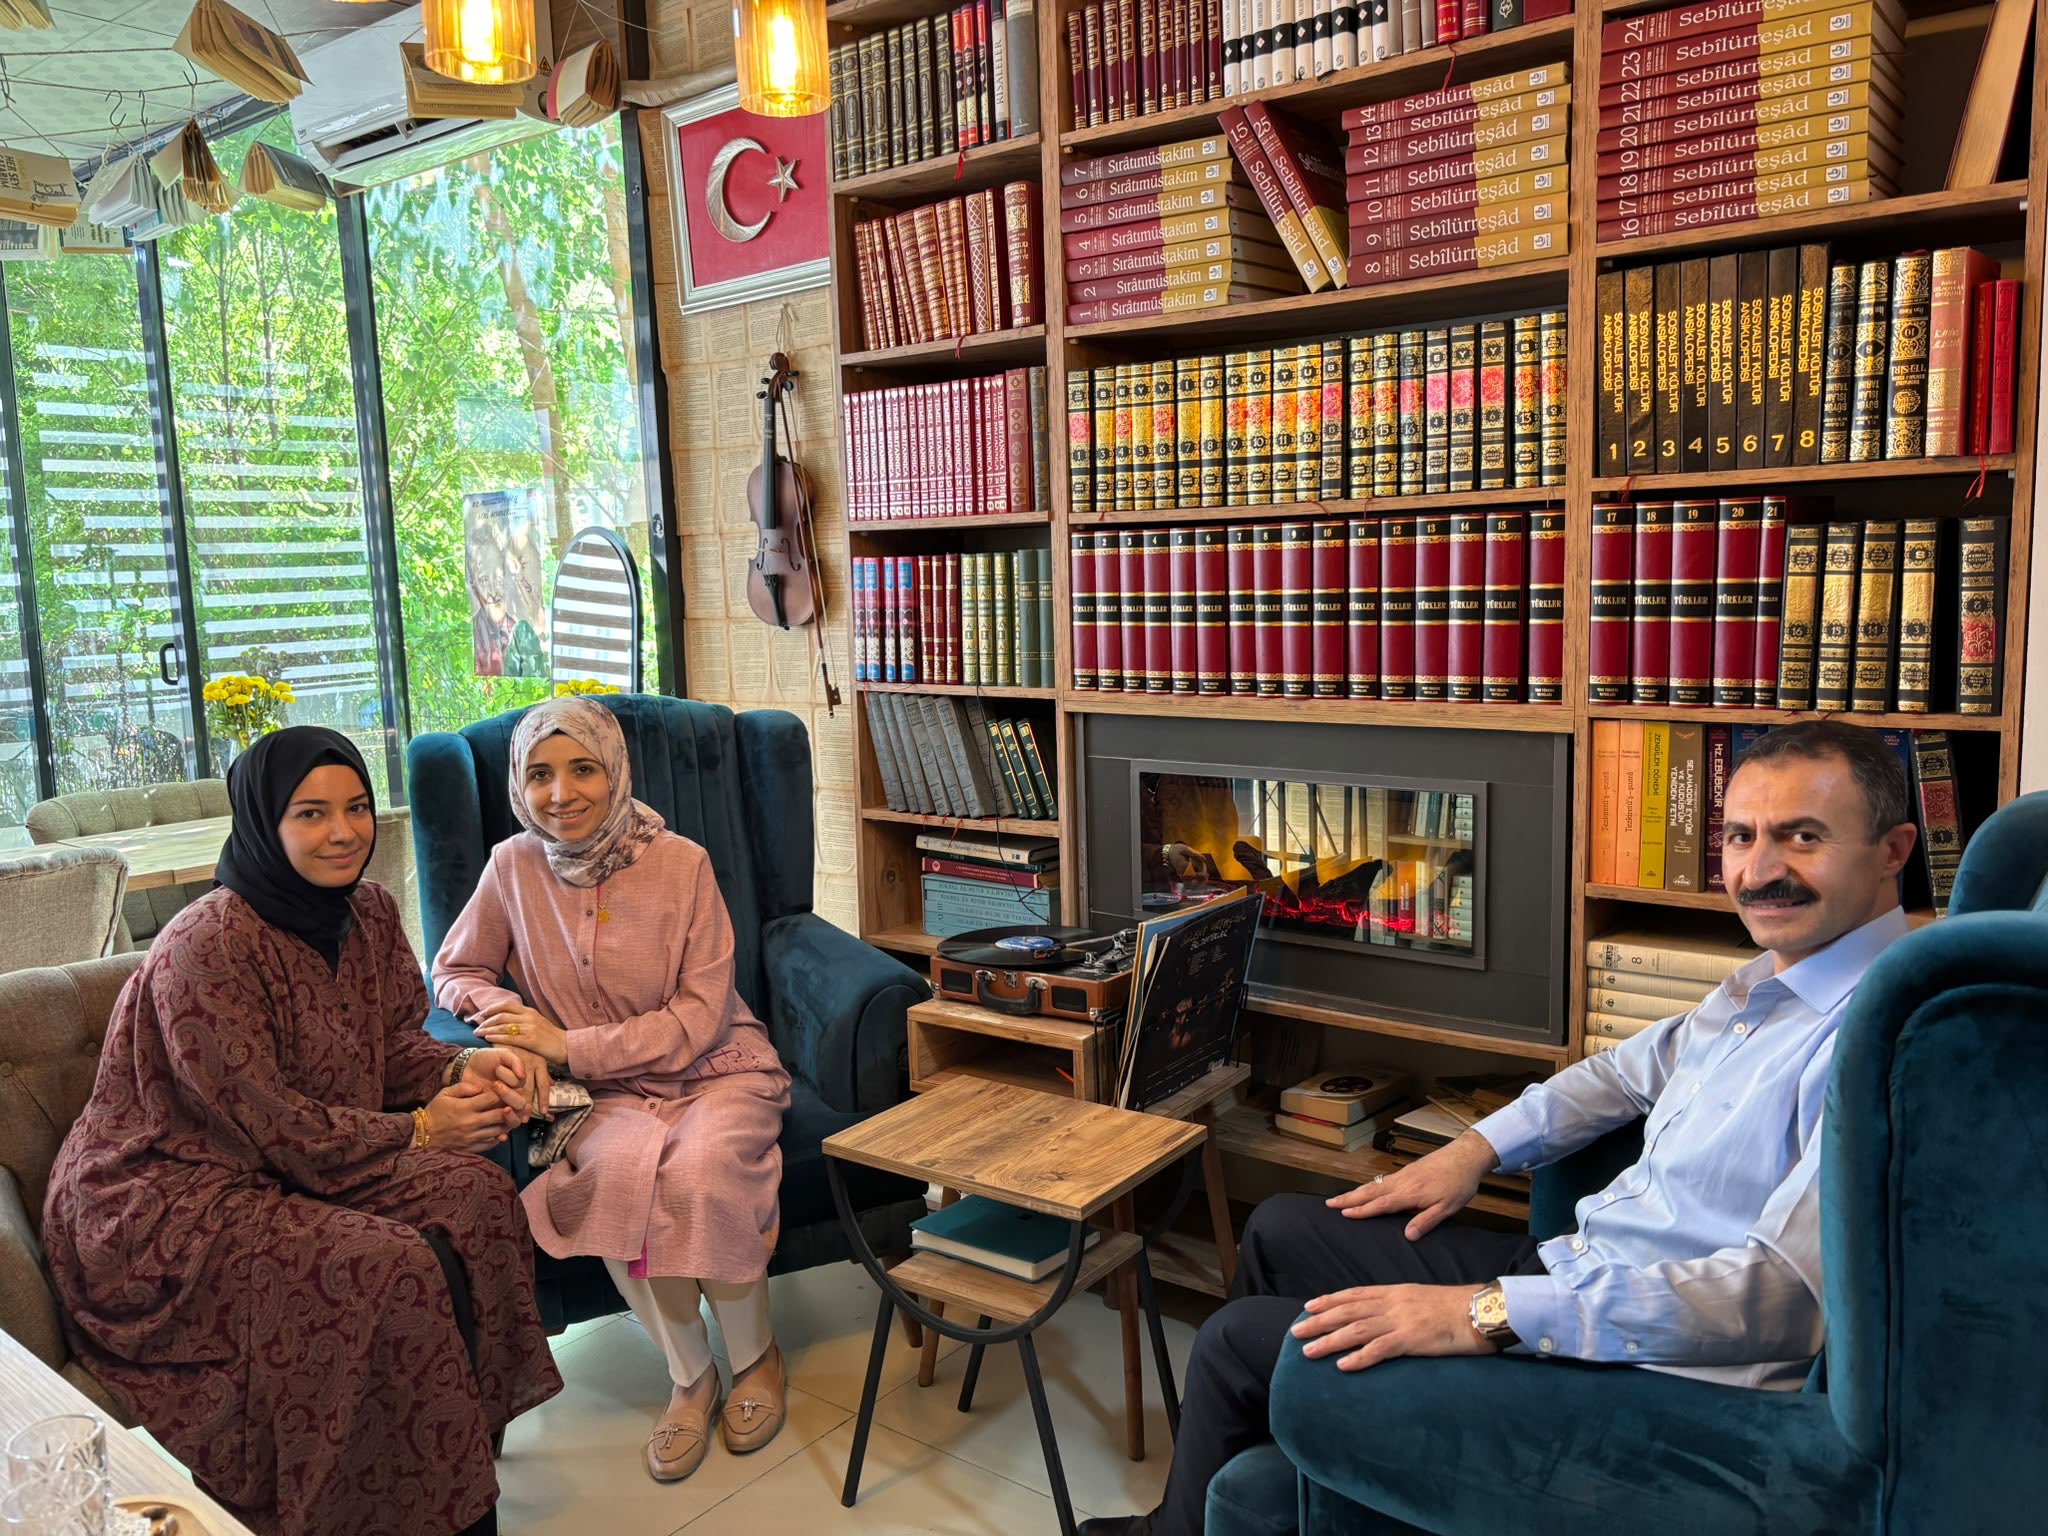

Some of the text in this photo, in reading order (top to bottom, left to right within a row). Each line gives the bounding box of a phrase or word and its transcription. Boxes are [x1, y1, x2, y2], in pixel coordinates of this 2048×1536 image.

[1624, 18, 1645, 44] 24
[1676, 20, 1812, 61] Sebîlürreşâd
[1621, 52, 1641, 79] 23
[1676, 50, 1812, 88] Sebîlürreşâd
[1176, 80, 1181, 88] 7
[1192, 76, 1197, 85] 8
[1209, 72, 1215, 81] 9
[1124, 91, 1129, 100] 4
[1144, 88, 1149, 97] 5
[1162, 84, 1167, 93] 6
[1403, 76, 1516, 113] Sebîlürreşâd
[1621, 81, 1641, 103] 22
[1676, 70, 1812, 110] Sebîlürreşâd
[1091, 99, 1096, 107] 2
[1109, 96, 1114, 104] 3
[1360, 106, 1376, 125] 14
[1410, 97, 1523, 132] Sebîlürreşâd
[1622, 104, 1641, 124] 21
[1673, 95, 1809, 134] Sebîlürreşâd
[1229, 121, 1249, 143] 15
[1253, 115, 1272, 138] 25
[1366, 124, 1382, 142] 13
[1407, 119, 1518, 157] Sebîlürreşâd
[1619, 127, 1638, 148] 20
[1674, 121, 1810, 158] Sebîlürreşâd
[1364, 146, 1380, 166] 12
[1620, 151, 1639, 172] 19
[1672, 147, 1808, 182] Sebîlürreşâd
[1074, 168, 1087, 178] 7
[1407, 150, 1518, 186] Sebîlürreşâd
[1365, 176, 1381, 196] 11
[1619, 174, 1638, 194] 18
[1672, 169, 1809, 205] Sebîlürreşâd
[1075, 188, 1088, 199] 6
[1410, 180, 1521, 212] Sebîlürreşâd
[1250, 160, 1307, 254] Sebîlürreşâd
[1274, 155, 1329, 250] Sebîlürreşâd
[1367, 201, 1383, 221] 10
[1618, 195, 1637, 217] 17
[1674, 191, 1810, 226] Sebîlürreşâd
[1074, 213, 1087, 224] 5
[1409, 208, 1520, 241] Sebîlürreşâd
[1621, 218, 1639, 239] 16
[1078, 240, 1091, 250] 4
[1366, 233, 1382, 246] 9
[1408, 237, 1520, 270] Sebîlürreşâd
[1079, 264, 1092, 275] 3
[1364, 261, 1381, 274] 8
[1083, 286, 1097, 297] 2
[1079, 310, 1092, 318] 1
[1231, 377, 1239, 385] K
[1253, 374, 1262, 382] U
[1280, 371, 1288, 380] T
[1779, 358, 1791, 402] KÜLTÜR
[1809, 352, 1822, 397] KÜLTÜR
[1640, 371, 1650, 412] KÜLTÜR
[1696, 365, 1707, 407] KÜLTÜR
[1722, 362, 1734, 405] KÜLTÜR
[1751, 362, 1762, 405] KÜLTÜR
[1614, 372, 1624, 413] KÜLTÜR
[1668, 372, 1679, 413] KÜLTÜR
[984, 392, 992, 420] TEMEL
[1688, 437, 1703, 453] 4
[1716, 437, 1730, 454] 5
[1743, 435, 1758, 452] 6
[1771, 434, 1785, 451] 7
[1800, 430, 1815, 448] 8
[1609, 443, 1617, 460] 1
[1633, 440, 1646, 457] 2
[1662, 440, 1676, 457] 3
[1606, 512, 1617, 522] 17
[1646, 511, 1657, 521] 18
[1687, 509, 1698, 519] 19
[1731, 507, 1744, 518] 20
[1767, 506, 1778, 516] 21
[1357, 527, 1365, 536] 11
[1392, 525, 1402, 535] 12
[1426, 523, 1437, 534] 13
[1460, 521, 1470, 532] 14
[1497, 520, 1507, 531] 15
[1541, 518, 1552, 529] 16
[1152, 536, 1157, 545] 4
[1177, 535, 1183, 544] 5
[1205, 534, 1211, 543] 6
[1237, 532, 1242, 541] 7
[1263, 532, 1268, 541] 8
[1291, 530, 1297, 540] 9
[1323, 528, 1333, 537] 10
[1079, 538, 1083, 547] 1
[1102, 538, 1107, 546] 2
[1127, 537, 1132, 546] 3
[1531, 597, 1562, 609] TÜRKLER
[1593, 594, 1627, 606] TÜRKLER
[1634, 594, 1667, 606] TÜRKLER
[1674, 594, 1709, 606] TÜRKLER
[1717, 593, 1753, 604] TÜRKLER
[1791, 626, 1802, 636] 16
[1831, 626, 1841, 636] 15
[1913, 625, 1920, 634] 3
[1654, 733, 1663, 769] ZENGİLER
[1653, 769, 1661, 796] DÖNEMİ
[1679, 770, 1685, 780] VE
[1686, 759, 1694, 806] SELAHADDİN
[1669, 766, 1678, 827] YENİDEN FETHİ
[1631, 956, 1642, 965] 8
